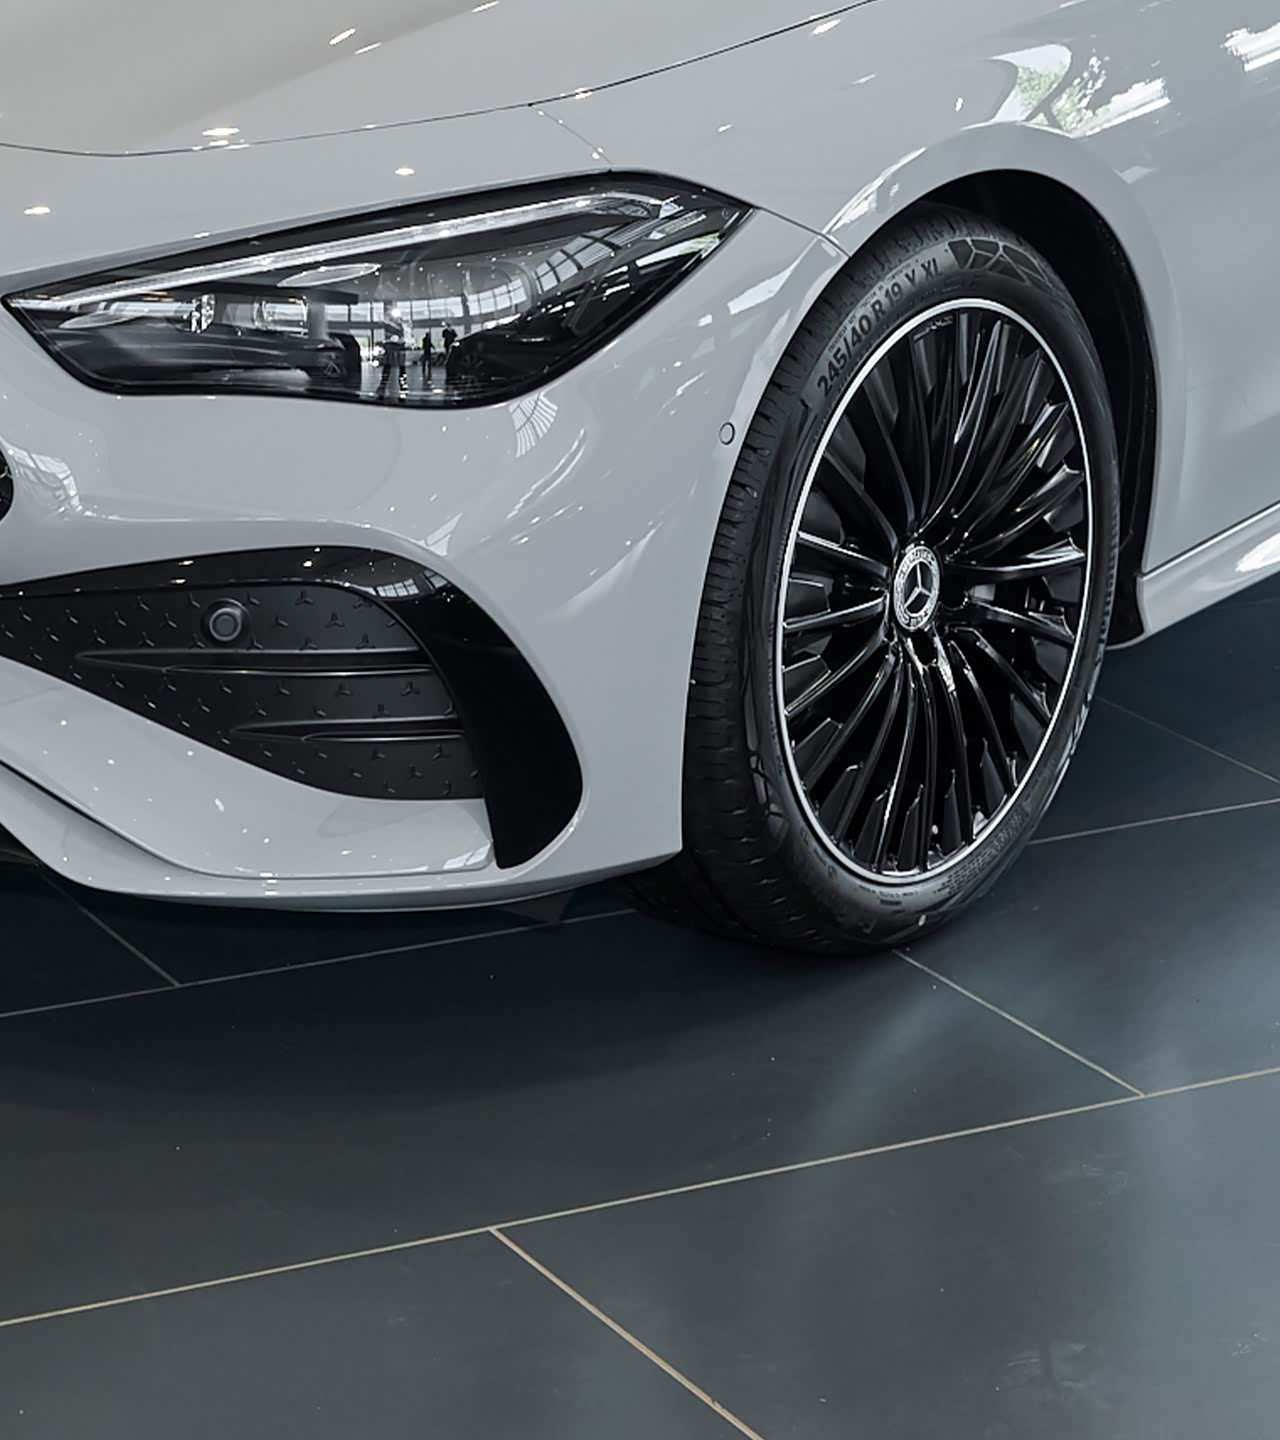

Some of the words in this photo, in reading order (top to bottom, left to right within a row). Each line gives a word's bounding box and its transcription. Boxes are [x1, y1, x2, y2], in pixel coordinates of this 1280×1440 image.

[817, 314, 871, 397] 245/40
[871, 299, 886, 322] R
[884, 282, 903, 306] 19
